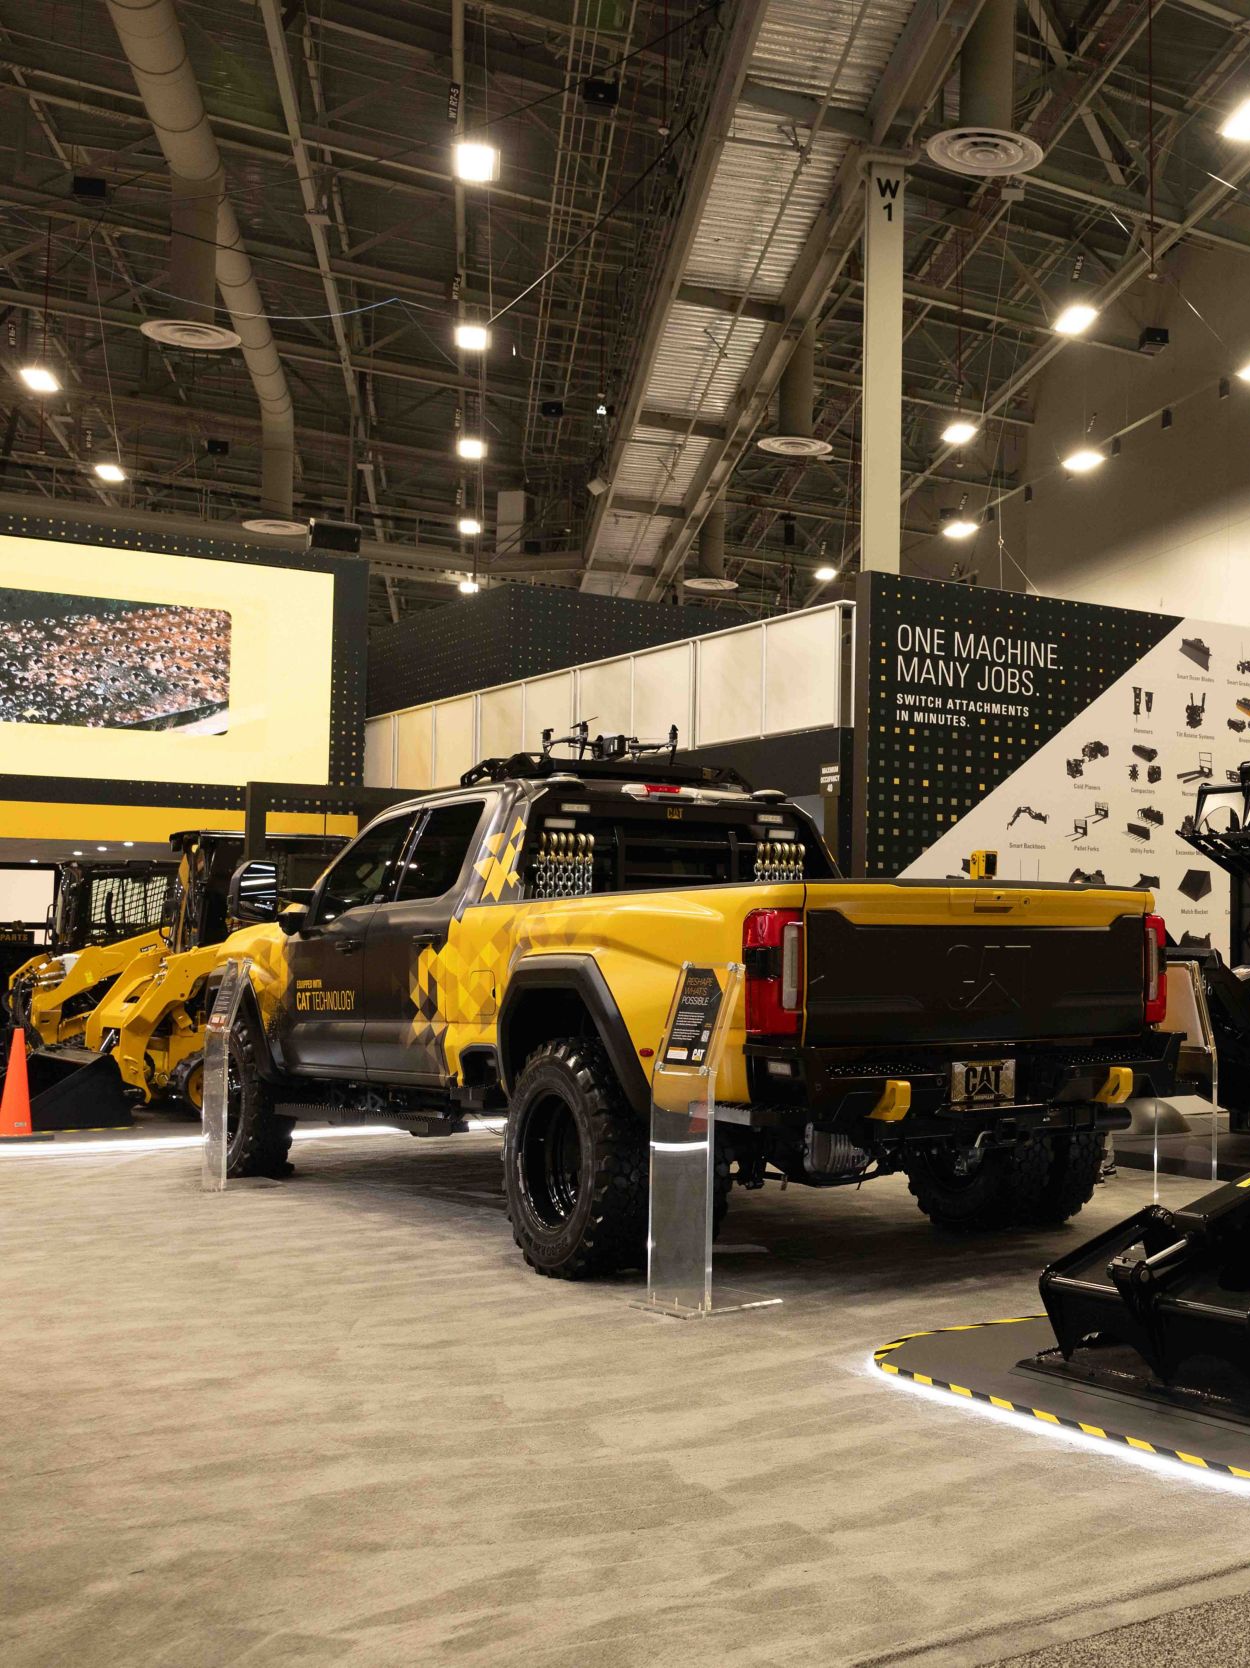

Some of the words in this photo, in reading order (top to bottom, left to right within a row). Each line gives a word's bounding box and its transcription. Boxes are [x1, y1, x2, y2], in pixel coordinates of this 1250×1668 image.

[450, 88, 459, 107] R7-5
[448, 107, 457, 119] W1
[876, 177, 900, 199] W
[883, 202, 893, 222] 1
[898, 624, 945, 656] ONE
[954, 632, 1064, 670] MACHINE.
[897, 655, 970, 688] MANY
[977, 666, 1040, 696] JOBS.
[896, 693, 942, 708] SWITCH
[946, 699, 1030, 718] ATTACHMENTS
[896, 710, 908, 722] IN
[914, 712, 970, 728] MINUTES.
[820, 774, 840, 784] OCCUPANCY
[668, 808, 683, 820] CAT
[296, 980, 312, 989] EQUIPPED
[313, 979, 322, 988] WITH
[686, 977, 713, 987] RESHAPE
[296, 991, 311, 1010] CAT
[312, 990, 355, 1010] TECHNOLOGY
[682, 996, 710, 1006] POSSIBLE
[965, 1066, 1004, 1096] CAT
